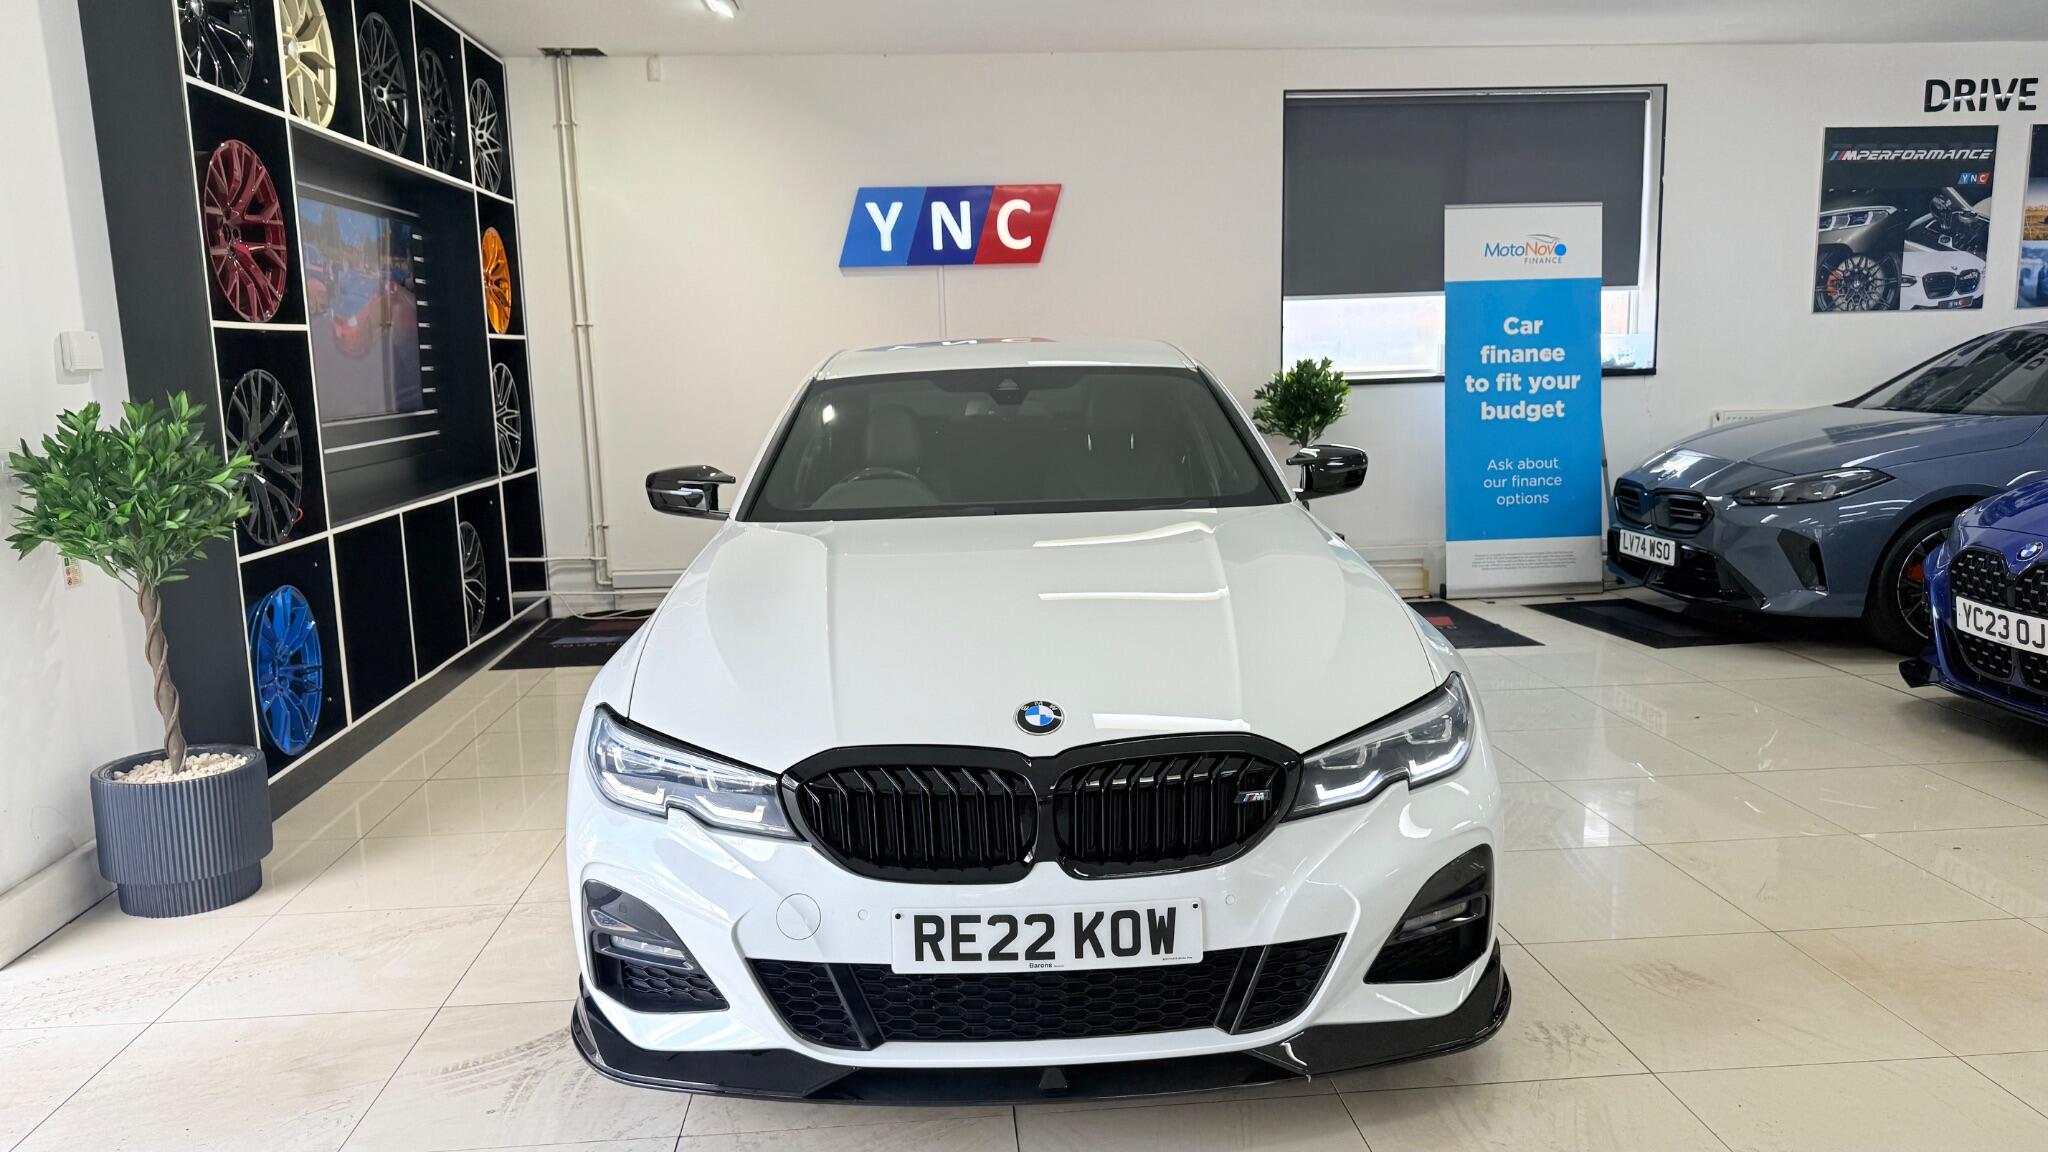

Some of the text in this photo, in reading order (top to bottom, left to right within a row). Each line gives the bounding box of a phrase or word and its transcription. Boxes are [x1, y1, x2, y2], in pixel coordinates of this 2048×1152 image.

[1923, 78, 2039, 112] DRIVE
[1961, 174, 1986, 183] YNC
[865, 199, 1032, 252] YNC
[1503, 316, 1543, 335] Car
[1480, 345, 1565, 364] finance
[1465, 373, 1581, 394] to fit your
[1481, 400, 1565, 422] budget
[1487, 457, 1559, 471] Ask about
[1483, 474, 1562, 488] our finance
[1496, 493, 1549, 507] options
[1623, 533, 1670, 560] LV74 WSO
[1963, 602, 2045, 649] YC23 OJ
[914, 906, 1177, 962] RE22 KOW
